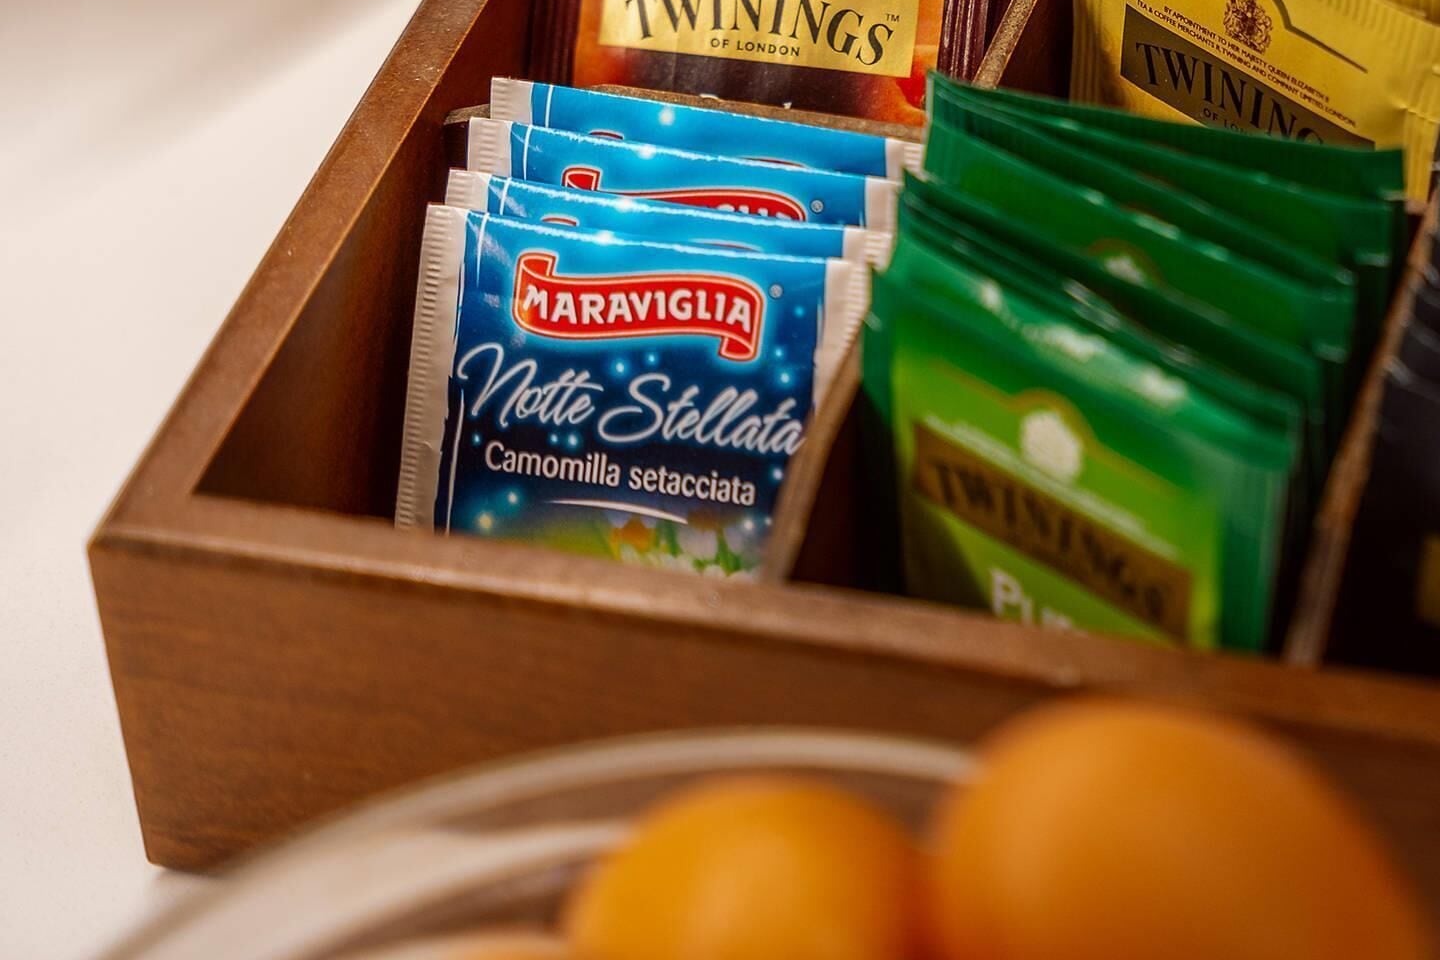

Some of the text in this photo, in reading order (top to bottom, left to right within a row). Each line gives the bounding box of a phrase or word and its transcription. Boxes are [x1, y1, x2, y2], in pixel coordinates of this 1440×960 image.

[710, 37, 800, 57] OF LONDON
[1135, 41, 1324, 145] TWININ
[1203, 108, 1219, 121] OF
[521, 283, 753, 333] MARAVIGLIA
[457, 343, 805, 456] Notte Stellata
[485, 442, 757, 507] Camomilla setacciata
